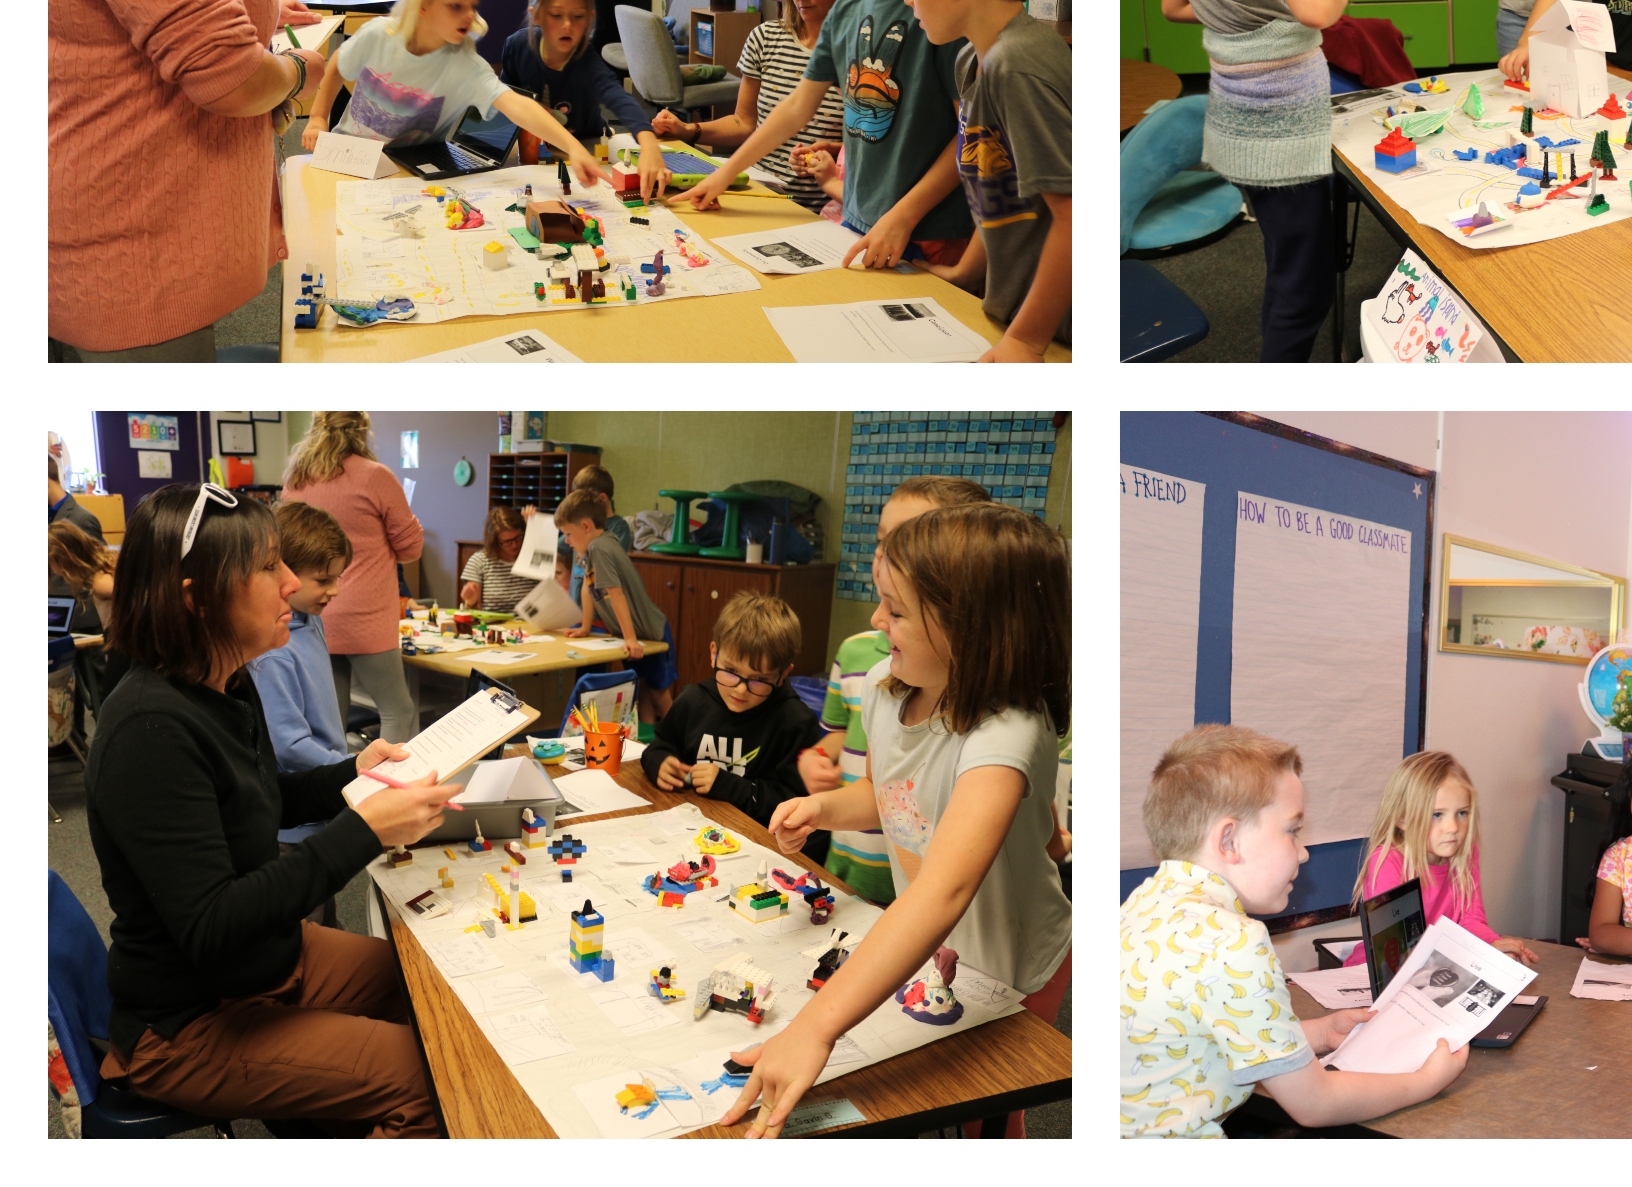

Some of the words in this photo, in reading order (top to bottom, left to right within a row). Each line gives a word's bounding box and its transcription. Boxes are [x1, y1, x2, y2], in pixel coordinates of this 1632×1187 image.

[1133, 471, 1187, 504] FRIEND
[1239, 497, 1267, 524] HOW
[1275, 505, 1291, 528] TO
[1296, 511, 1312, 534] BE
[1316, 516, 1324, 537] A
[1330, 518, 1354, 540] GOOD
[1358, 525, 1408, 554] CLASSMATE
[696, 733, 747, 766] ALL
[794, 1115, 823, 1125] Gavin
